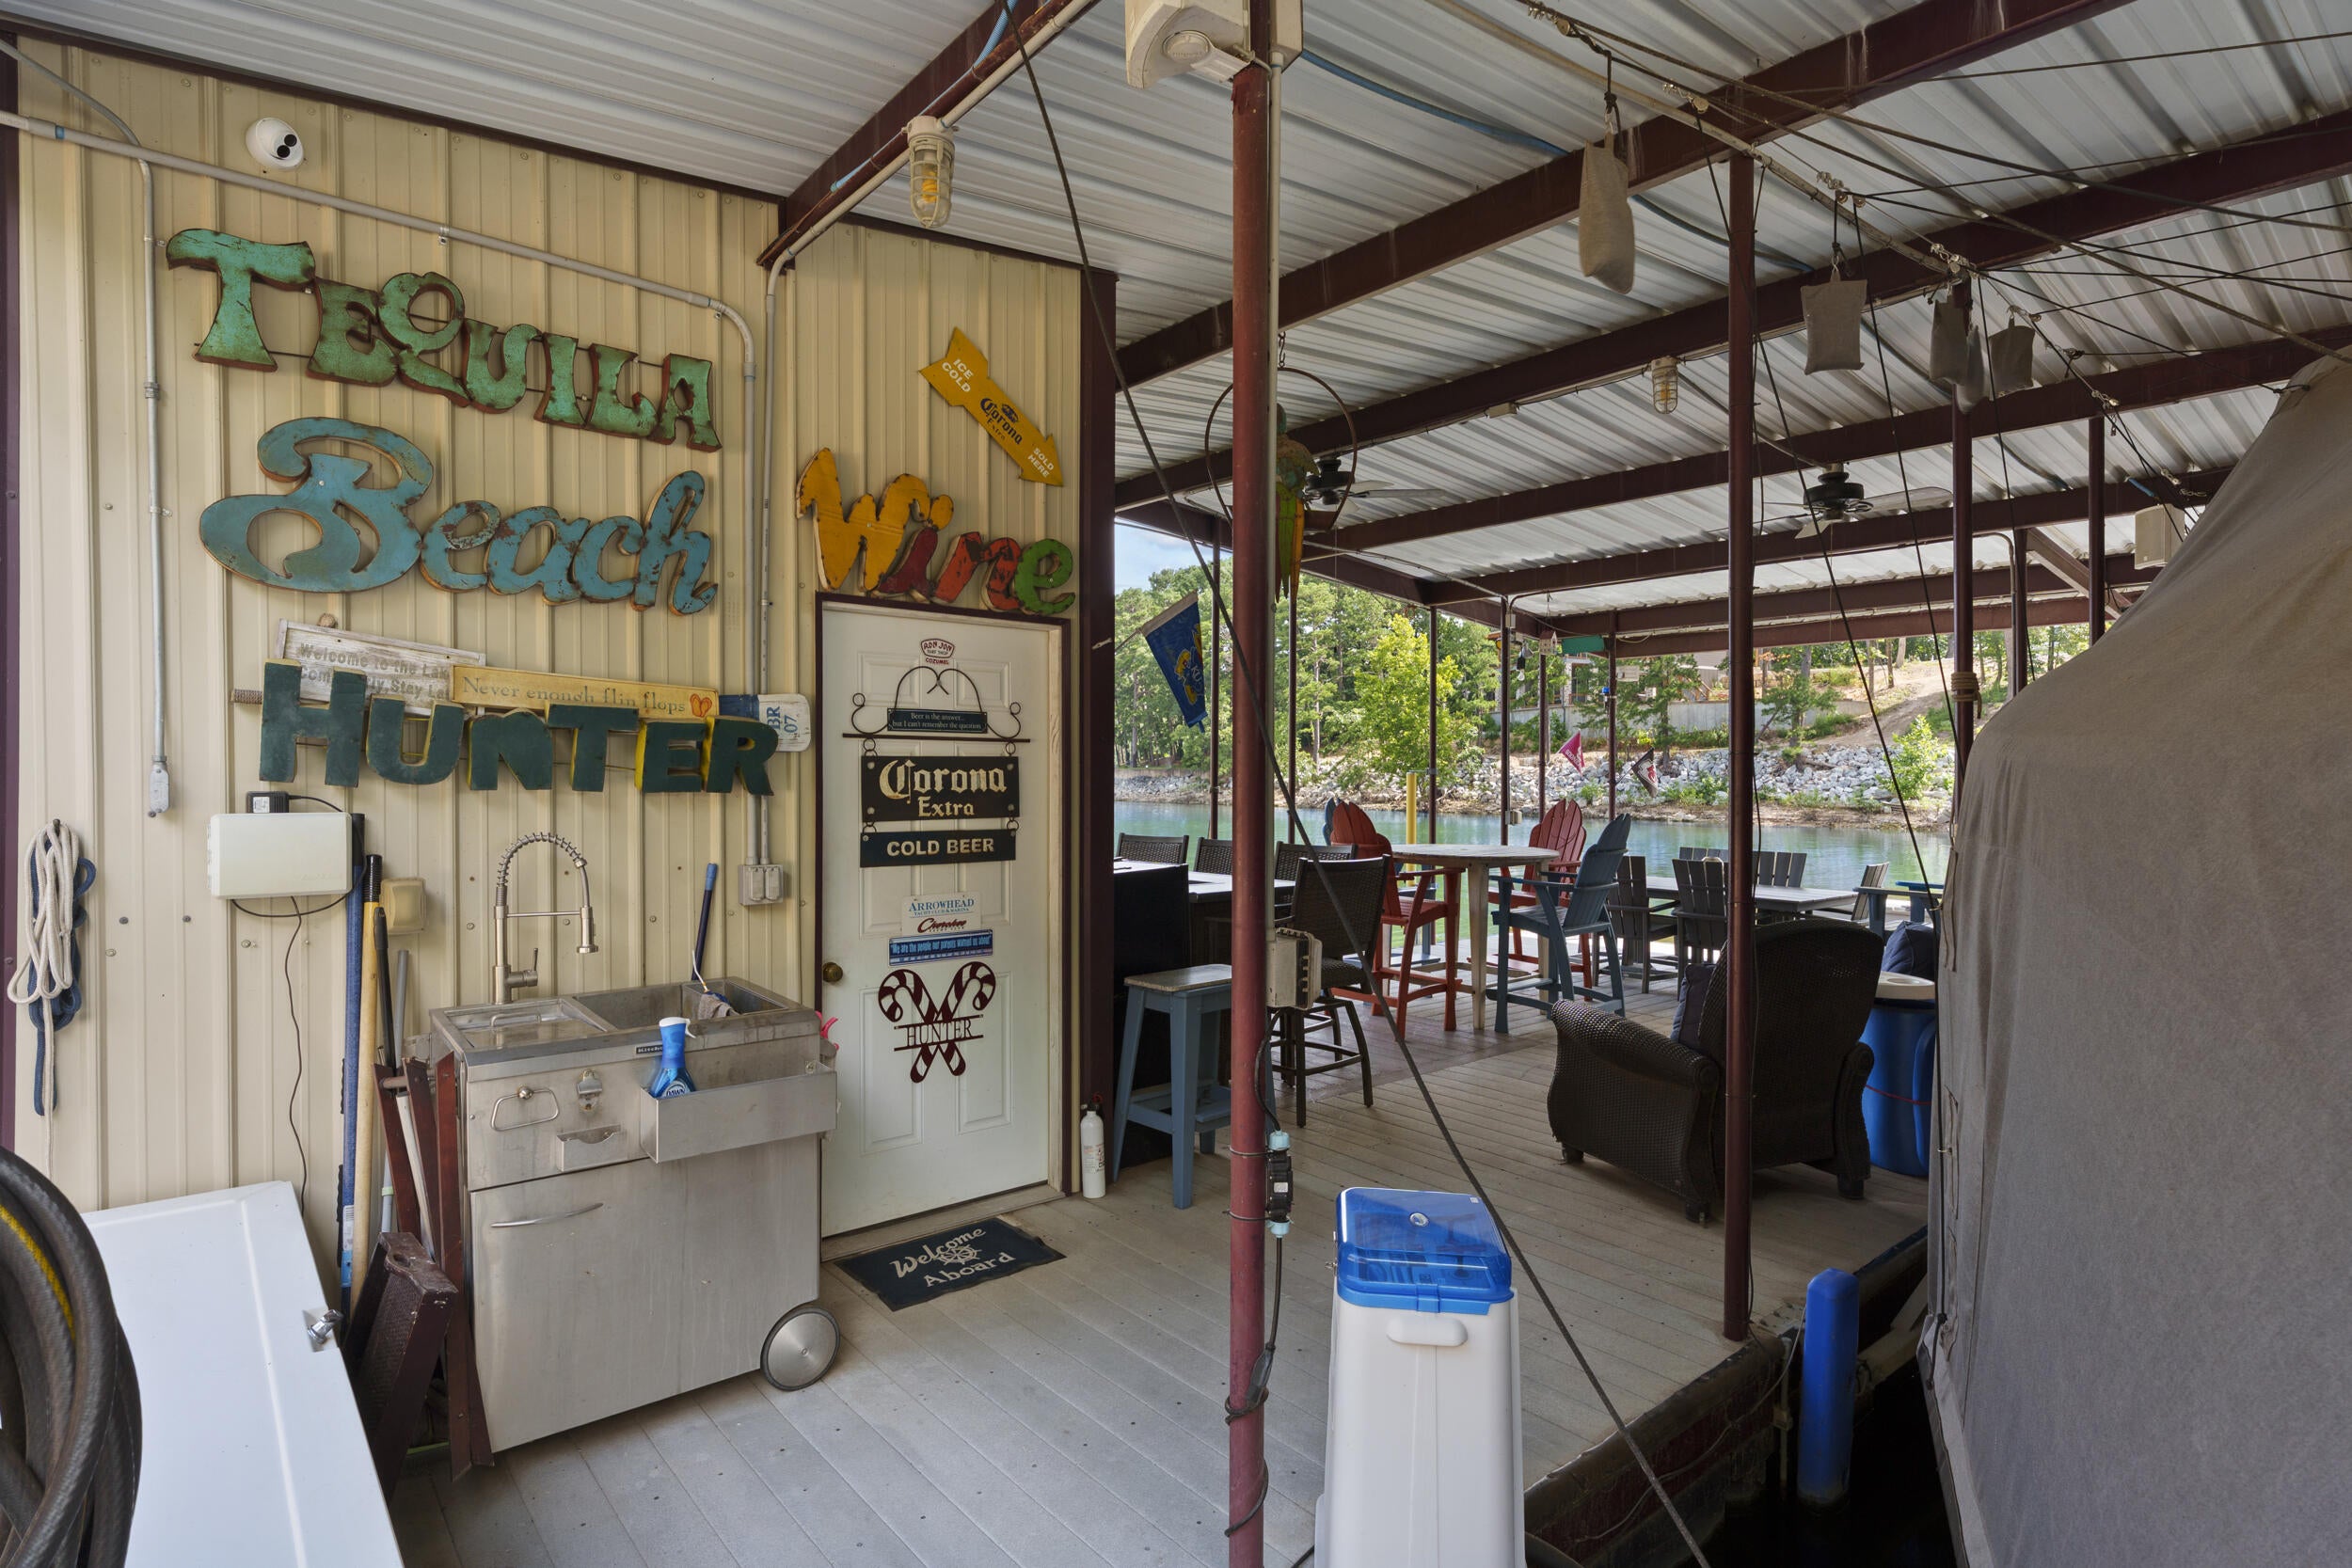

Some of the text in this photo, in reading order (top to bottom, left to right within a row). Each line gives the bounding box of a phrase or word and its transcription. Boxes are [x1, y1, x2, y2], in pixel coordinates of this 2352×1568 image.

[166, 227, 723, 453] TEQUILA
[942, 361, 971, 392] COLD
[953, 358, 975, 380] ICE
[980, 398, 1023, 445] Corona
[987, 418, 1006, 440] Extra
[1027, 454, 1050, 478] HERE
[1033, 448, 1055, 471] SOLD
[199, 416, 719, 616] Beach
[796, 446, 1076, 617] Wine
[923, 641, 937, 650] RON
[299, 642, 451, 679] Welcome to the Lak
[925, 657, 949, 665] COZUMEL
[300, 664, 330, 684] Com
[462, 676, 519, 698] Never
[644, 691, 686, 715] flops
[259, 657, 780, 797] HUNTER
[766, 705, 781, 730] BR
[784, 714, 798, 734] 07
[911, 712, 924, 721] Beer
[930, 713, 940, 721] the
[879, 759, 1008, 804] Corona
[917, 796, 975, 817] Extra
[886, 838, 994, 857] COLD BEER
[909, 898, 975, 911] ARROWHEAD
[906, 1018, 973, 1047] HUNTER
[889, 1227, 987, 1278] Welcome
[923, 1251, 1016, 1288] Aboard
